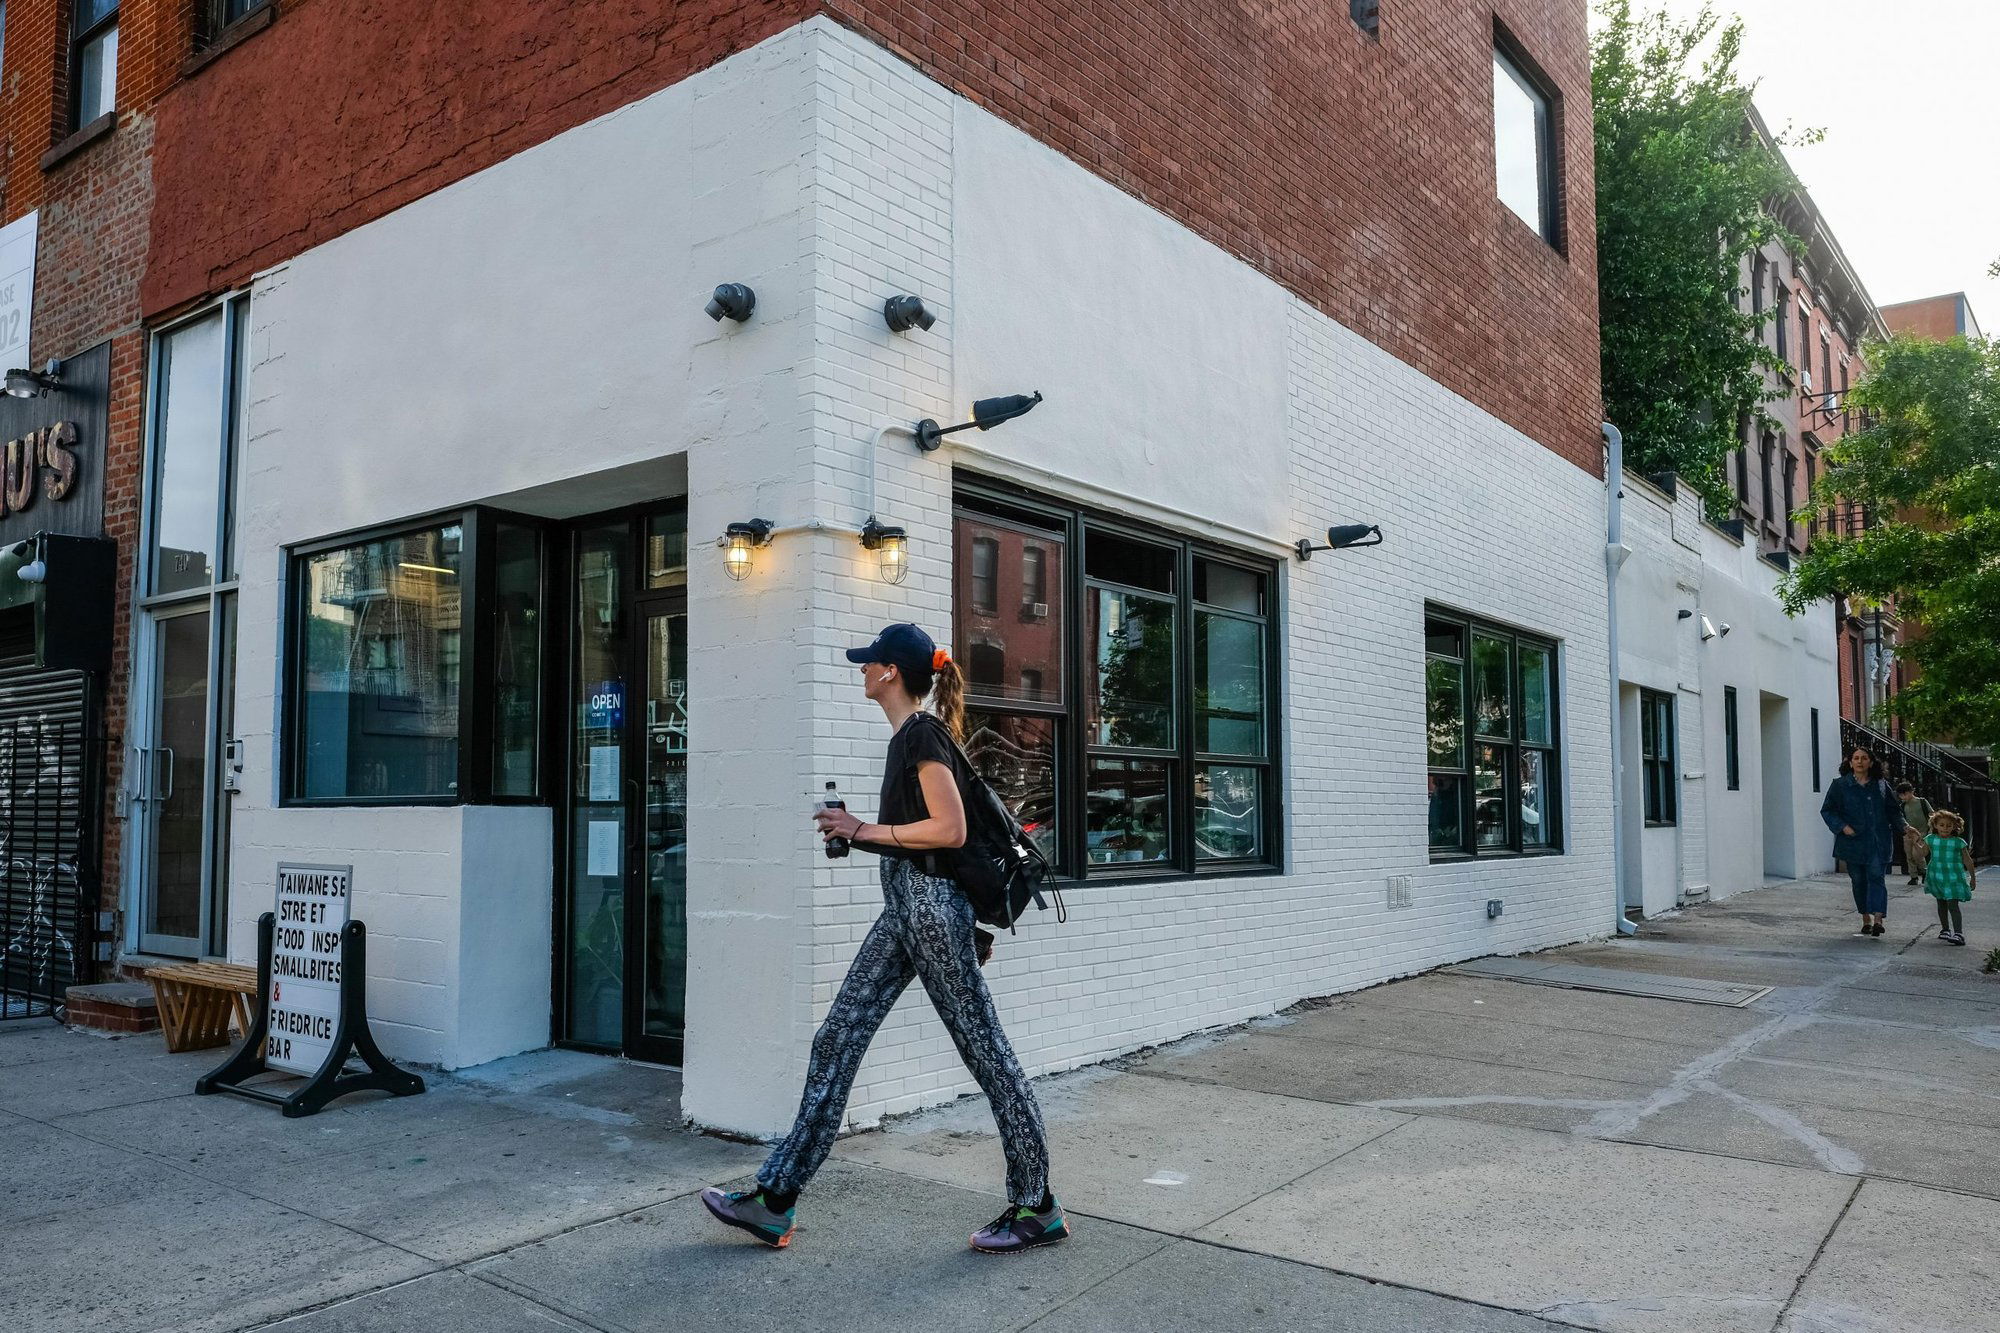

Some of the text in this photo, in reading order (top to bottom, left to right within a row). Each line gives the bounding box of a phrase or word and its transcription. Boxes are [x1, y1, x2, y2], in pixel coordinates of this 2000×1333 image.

[592, 693, 621, 710] OPEN
[280, 873, 346, 897] TAIWANESE
[281, 900, 326, 924] STREET
[277, 927, 305, 950] FOOD
[273, 982, 280, 1002] &
[268, 1036, 291, 1060] BAR
